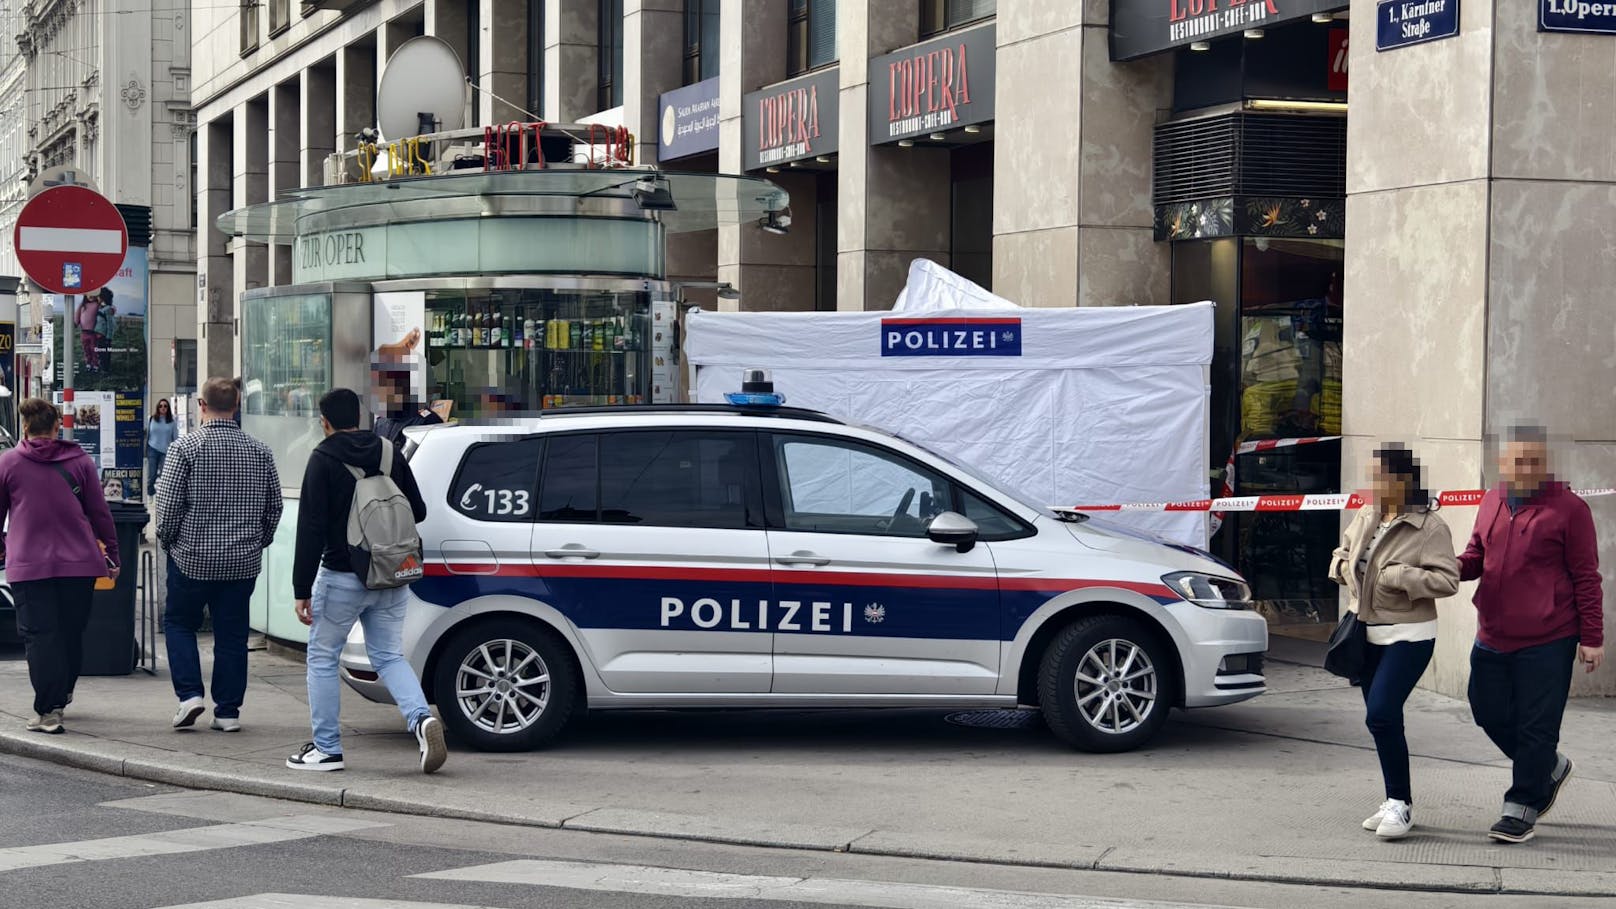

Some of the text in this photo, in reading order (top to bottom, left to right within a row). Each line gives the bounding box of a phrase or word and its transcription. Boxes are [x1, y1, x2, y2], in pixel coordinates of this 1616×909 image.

[1401, 0, 1445, 20] Kärntner
[1401, 18, 1431, 38] Straße
[889, 43, 971, 121] L'OPERA
[759, 85, 821, 152] L'OPERA
[302, 232, 366, 270] ZUR OPER
[116, 267, 133, 278] aft
[887, 331, 996, 349] POLIZEI
[104, 469, 128, 479] MERCI
[484, 489, 529, 515] 133
[1216, 500, 1249, 508] POLIZEI
[1261, 499, 1295, 507] POLIZEI
[1306, 498, 1340, 506] POLIZEI
[1442, 494, 1476, 502] POLIZEI
[394, 567, 423, 578] adidas
[660, 597, 853, 632] POLIZEI
